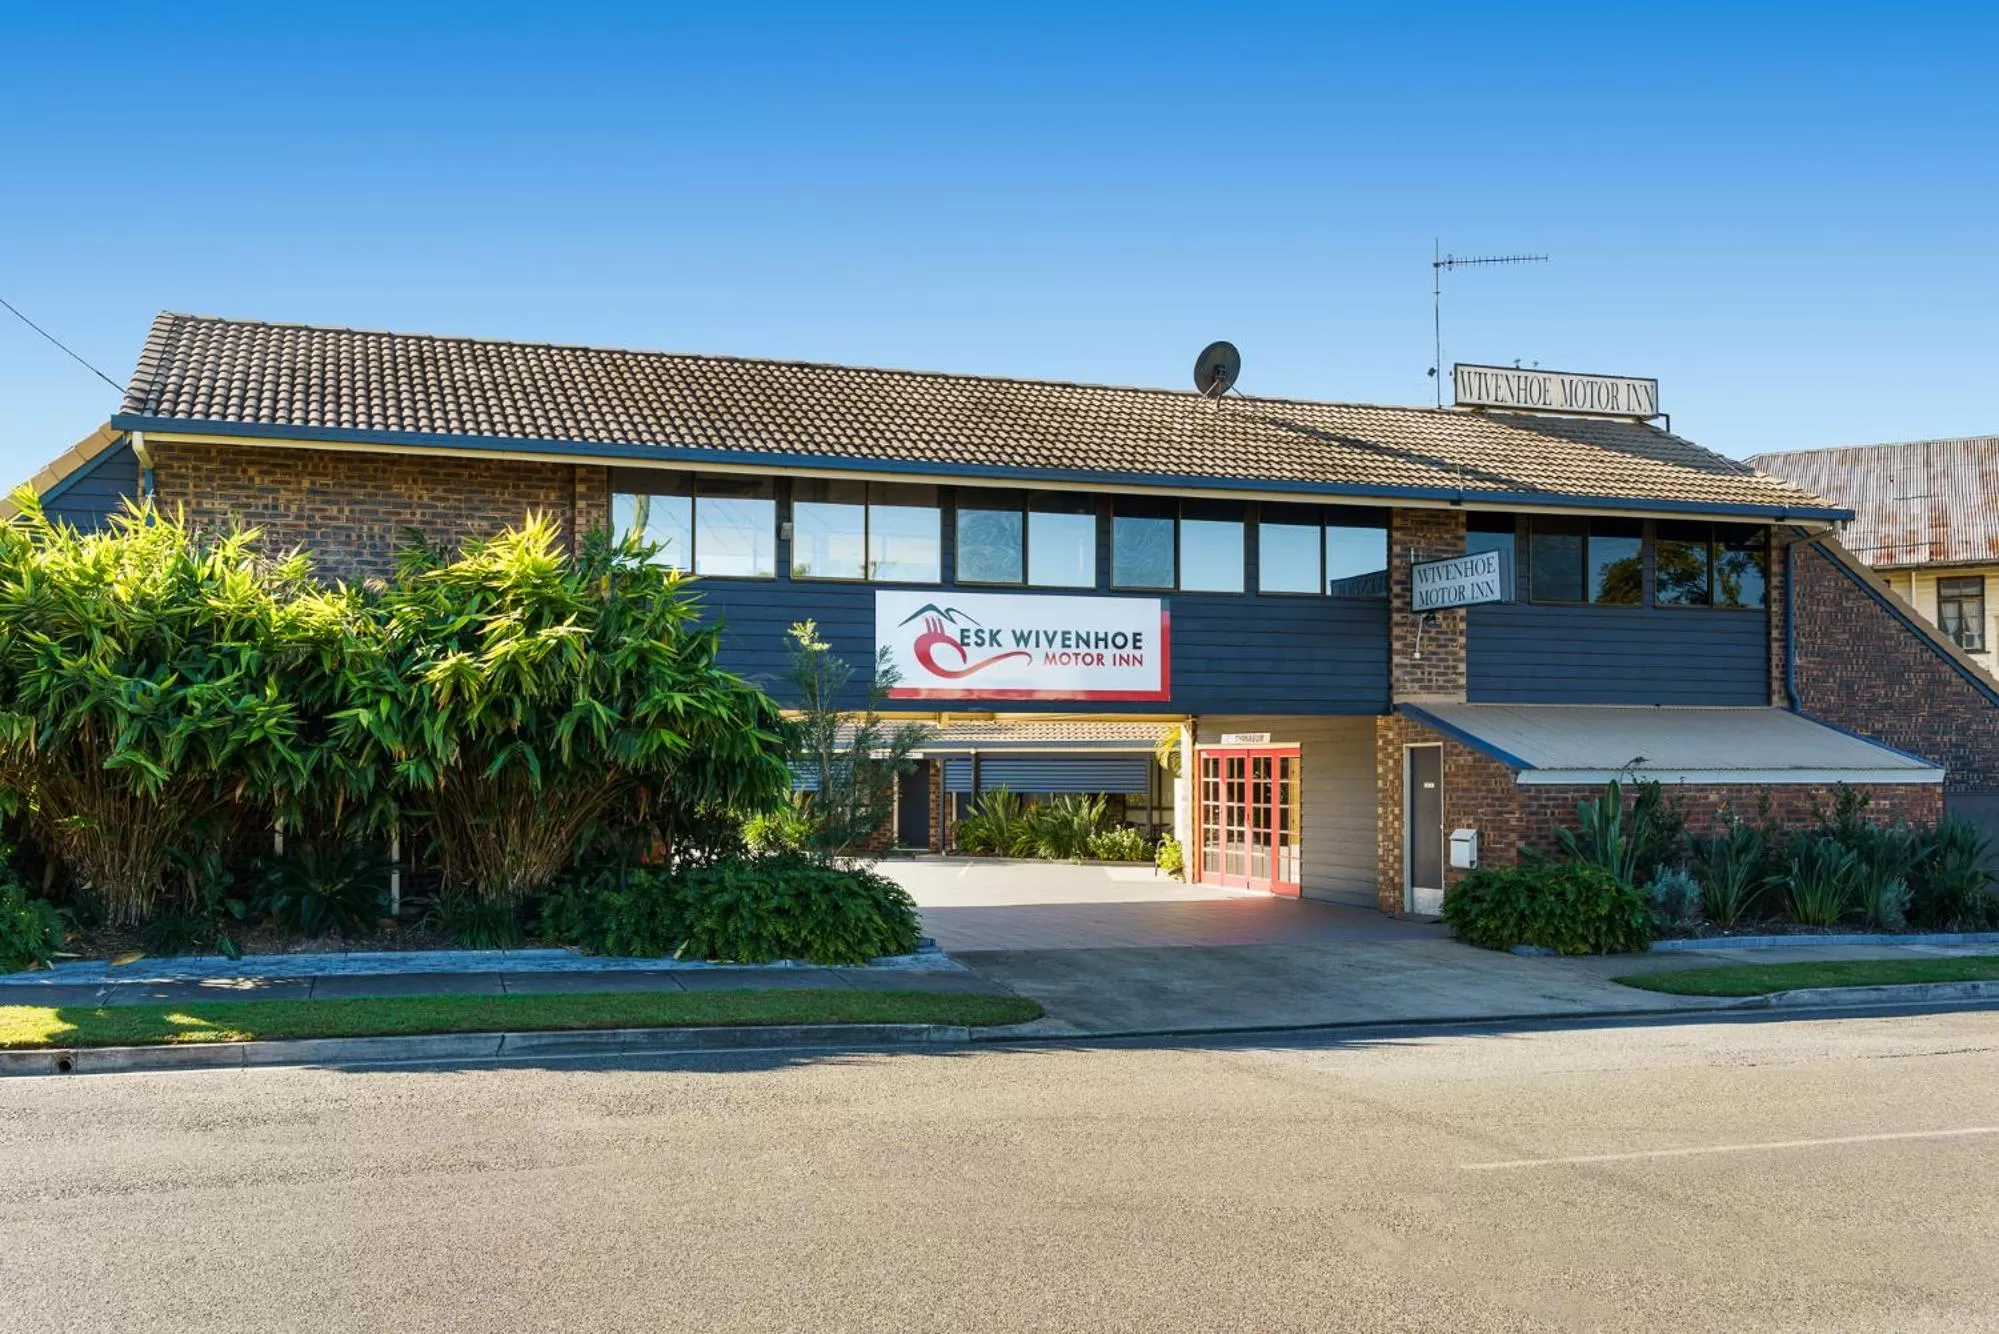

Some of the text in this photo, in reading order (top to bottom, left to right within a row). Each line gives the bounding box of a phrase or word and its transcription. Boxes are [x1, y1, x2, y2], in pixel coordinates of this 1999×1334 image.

[1460, 370, 1656, 413] WIVENHOE MOTOR INN
[1418, 556, 1496, 584] WIVENHOE
[1419, 580, 1495, 607] MOTOR INN
[960, 628, 1143, 650] ESK WIVENHOE
[1044, 652, 1143, 667] MOTOR INN
